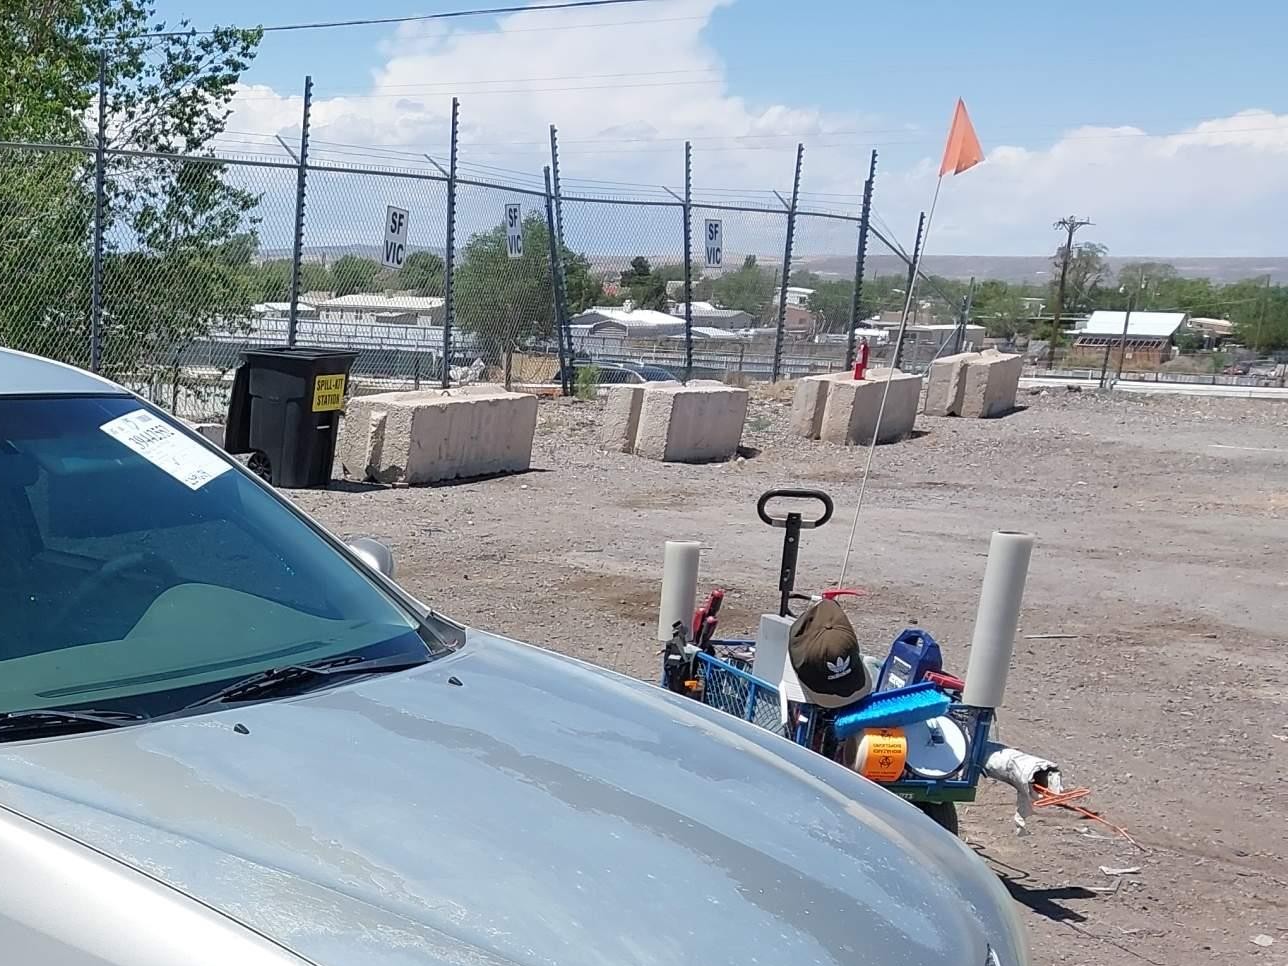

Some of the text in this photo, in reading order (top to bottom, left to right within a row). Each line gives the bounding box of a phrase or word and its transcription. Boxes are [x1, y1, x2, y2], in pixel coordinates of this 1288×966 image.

[390, 211, 405, 235] SF
[508, 207, 518, 228] SF
[708, 223, 719, 241] SF
[385, 240, 404, 265] VIC
[507, 234, 522, 255] VIC
[706, 247, 721, 265] VIC
[316, 378, 344, 391] SPILL-KIT
[316, 394, 341, 406] STATION
